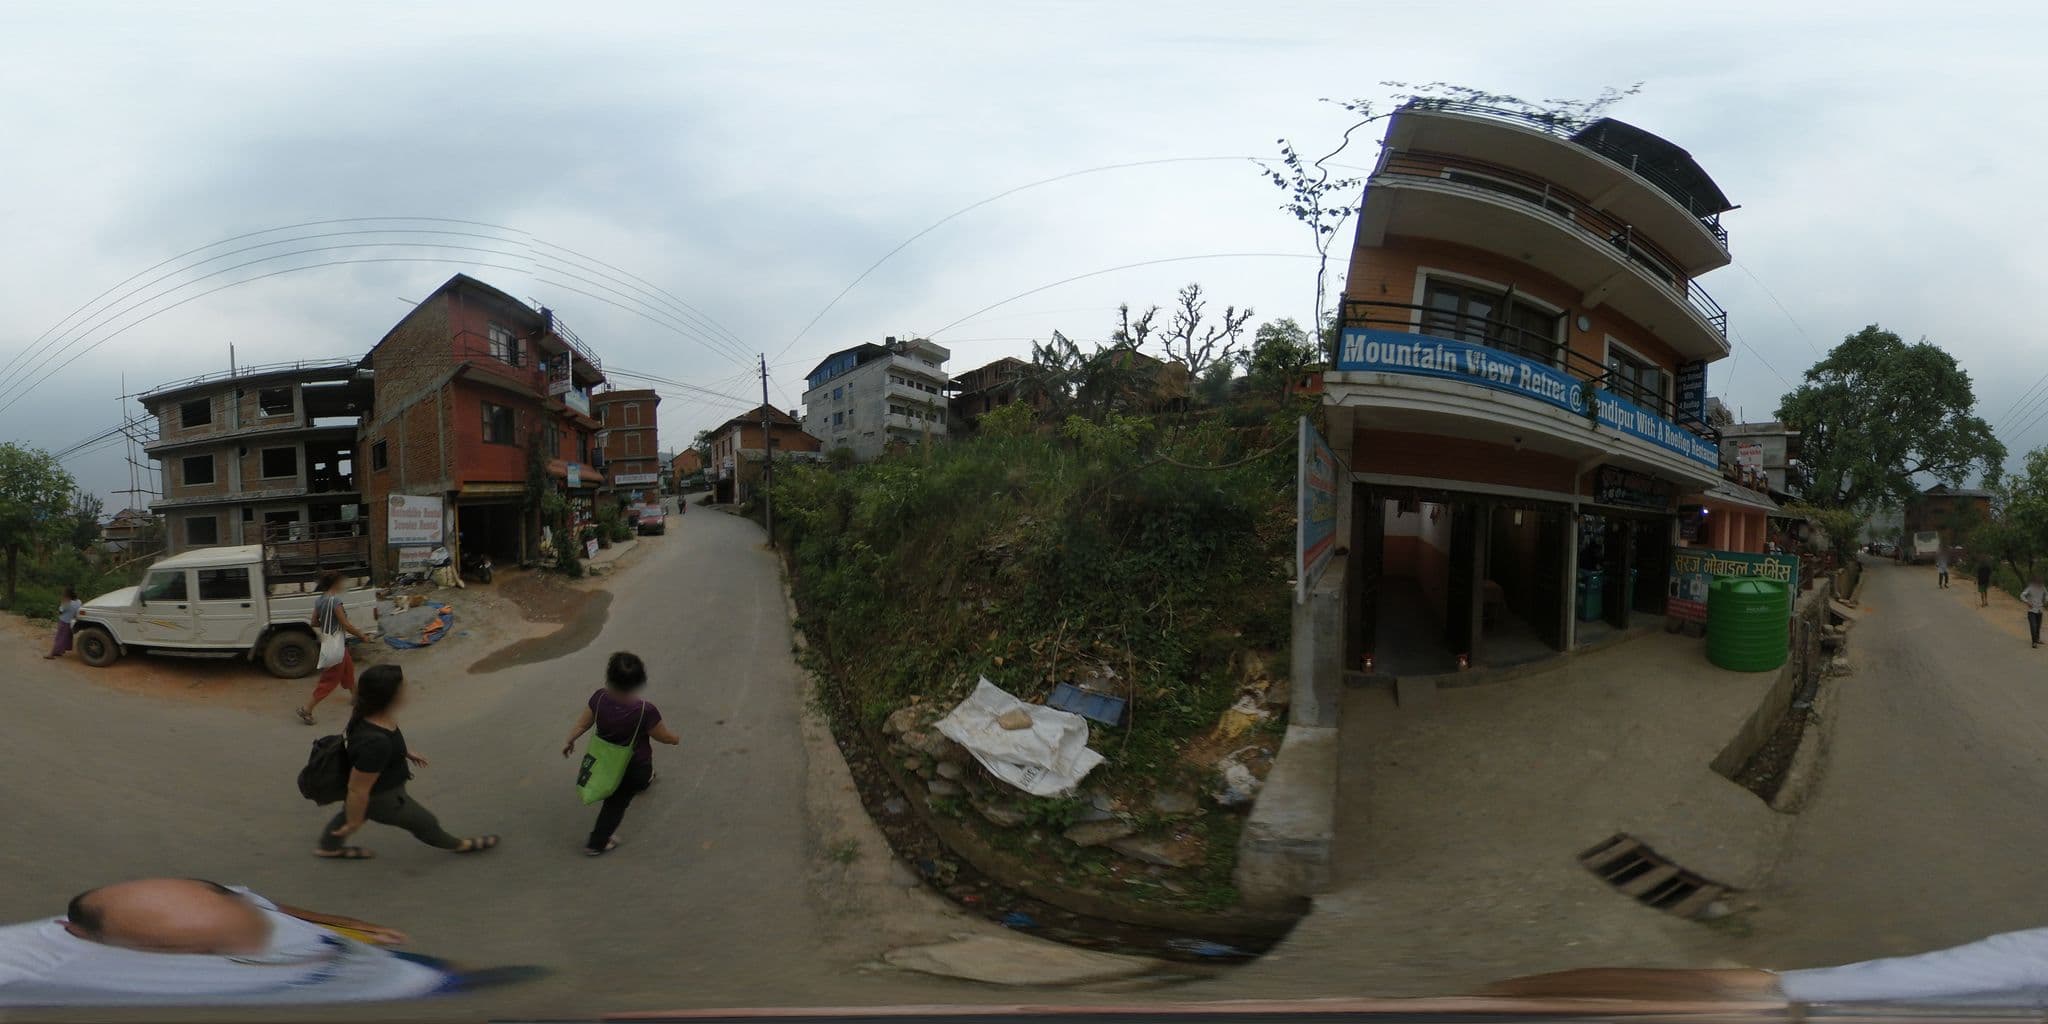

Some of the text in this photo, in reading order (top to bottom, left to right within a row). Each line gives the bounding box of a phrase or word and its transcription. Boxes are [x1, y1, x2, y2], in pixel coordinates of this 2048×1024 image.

[1343, 333, 1457, 374] Mountain
[1466, 349, 1515, 385] View
[1587, 397, 1634, 431] andipur
[1637, 410, 1656, 438] With
[1657, 421, 1664, 442] A
